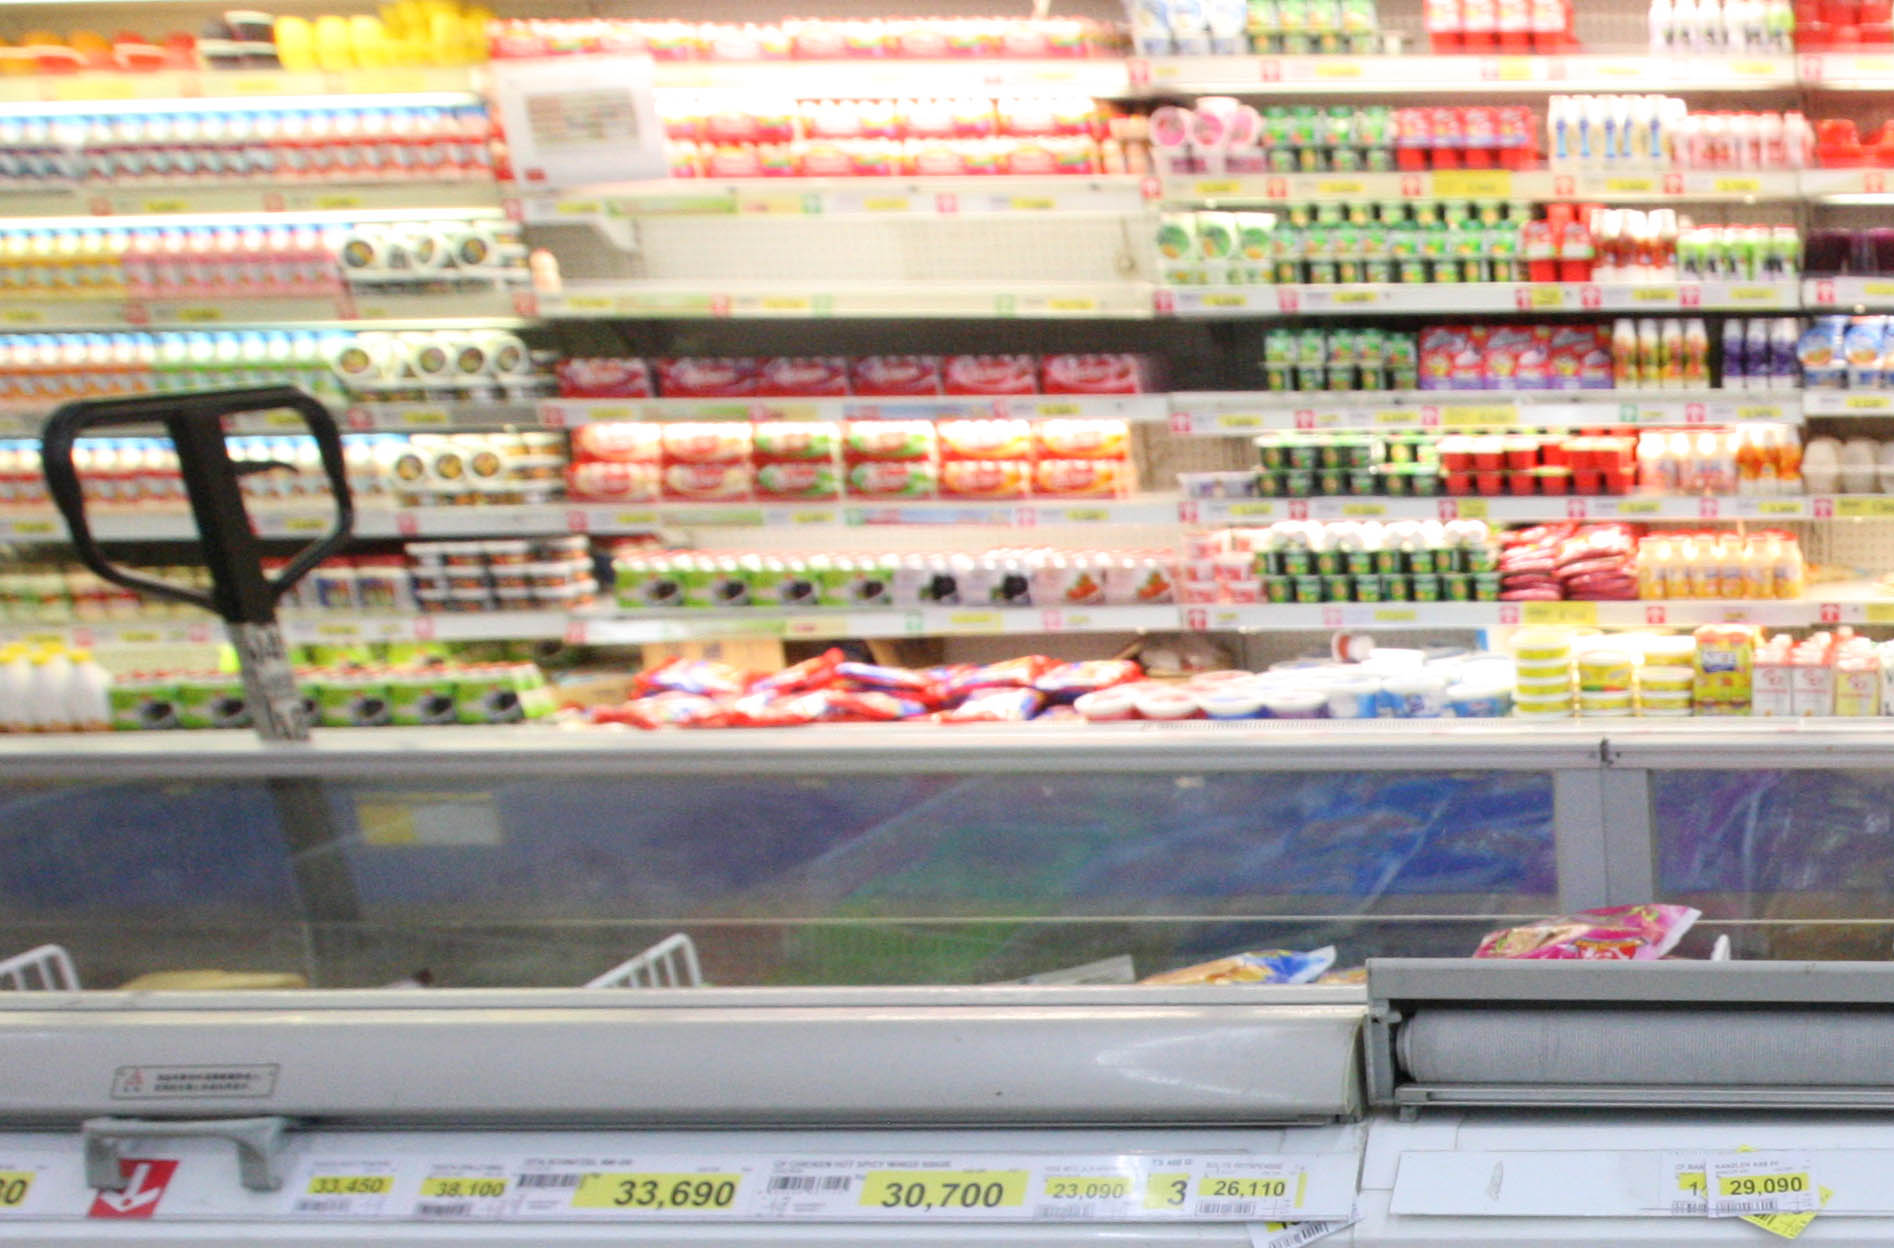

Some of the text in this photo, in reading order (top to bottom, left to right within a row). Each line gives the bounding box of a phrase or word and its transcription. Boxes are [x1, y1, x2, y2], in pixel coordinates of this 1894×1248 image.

[312, 1177, 385, 1195] 33,450
[434, 1180, 505, 1197] 38,100
[613, 1179, 736, 1210] 33,690
[1052, 1183, 1125, 1200] 23,090
[1213, 1180, 1286, 1197] 26,110
[1730, 1176, 1803, 1197] 29,090
[881, 1181, 1004, 1210] 30,700
